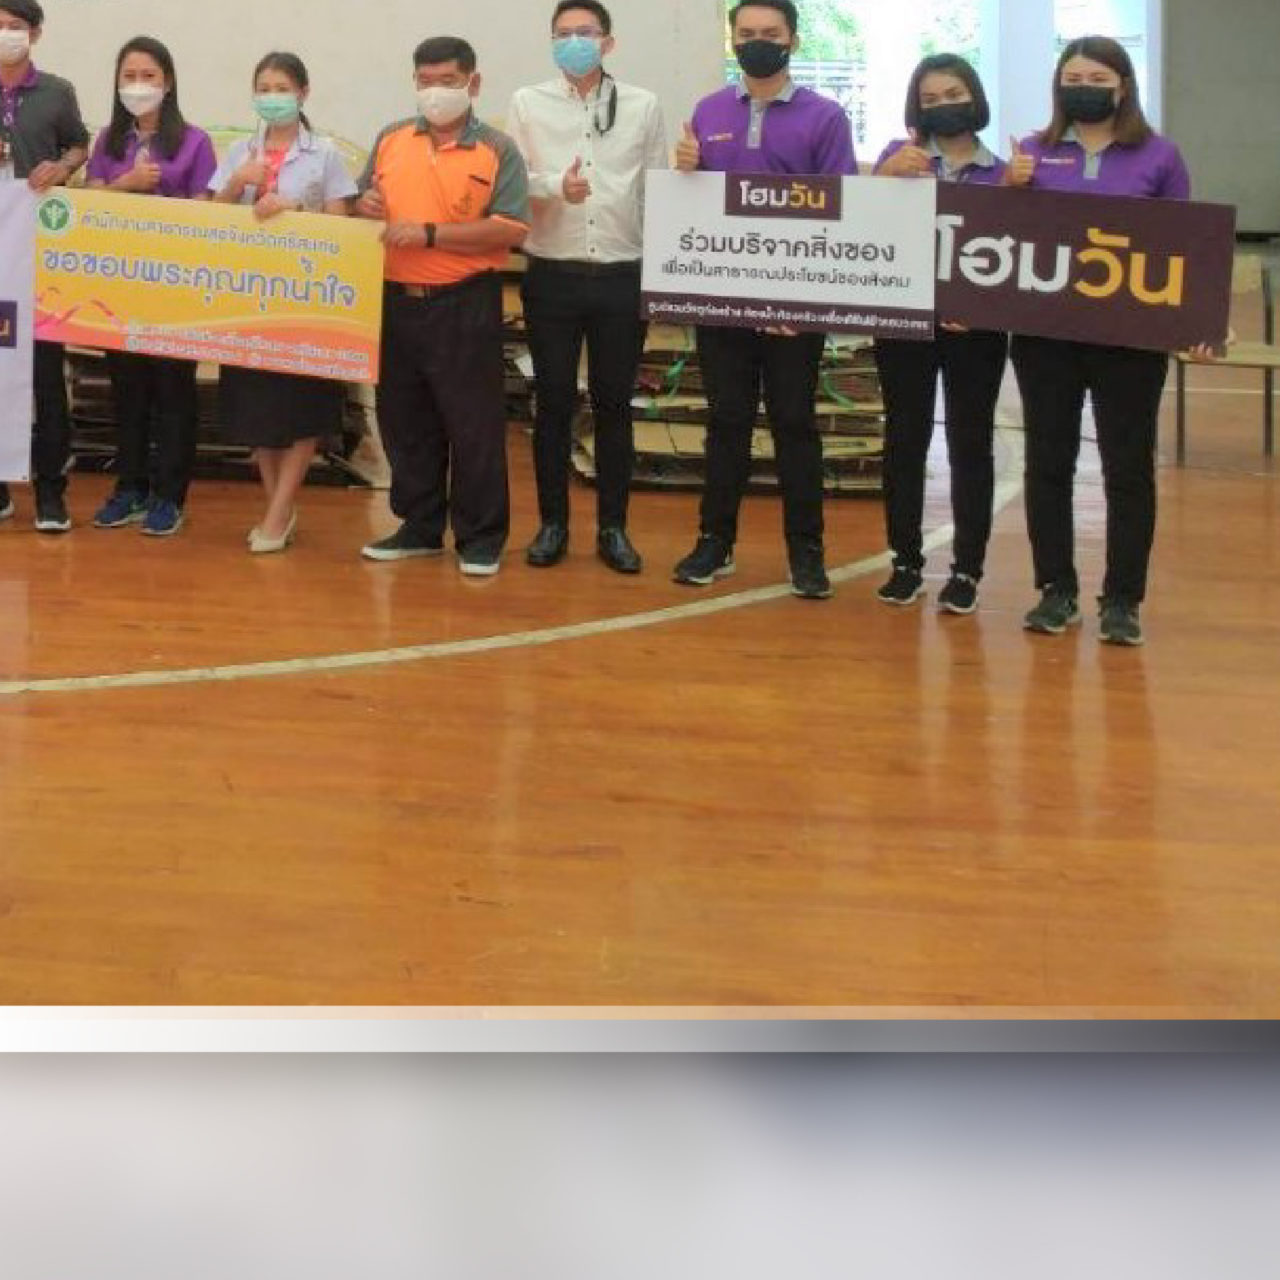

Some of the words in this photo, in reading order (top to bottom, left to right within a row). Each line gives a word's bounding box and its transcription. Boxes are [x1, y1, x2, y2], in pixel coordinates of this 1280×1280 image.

[740, 181, 826, 209] โฮมวัน
[679, 227, 896, 263] ร่วมบริจาคสิ่งของ
[935, 214, 1184, 306] โฮมวัน
[42, 249, 357, 312] ขอขอบพระคุณทุกน้ำใจ
